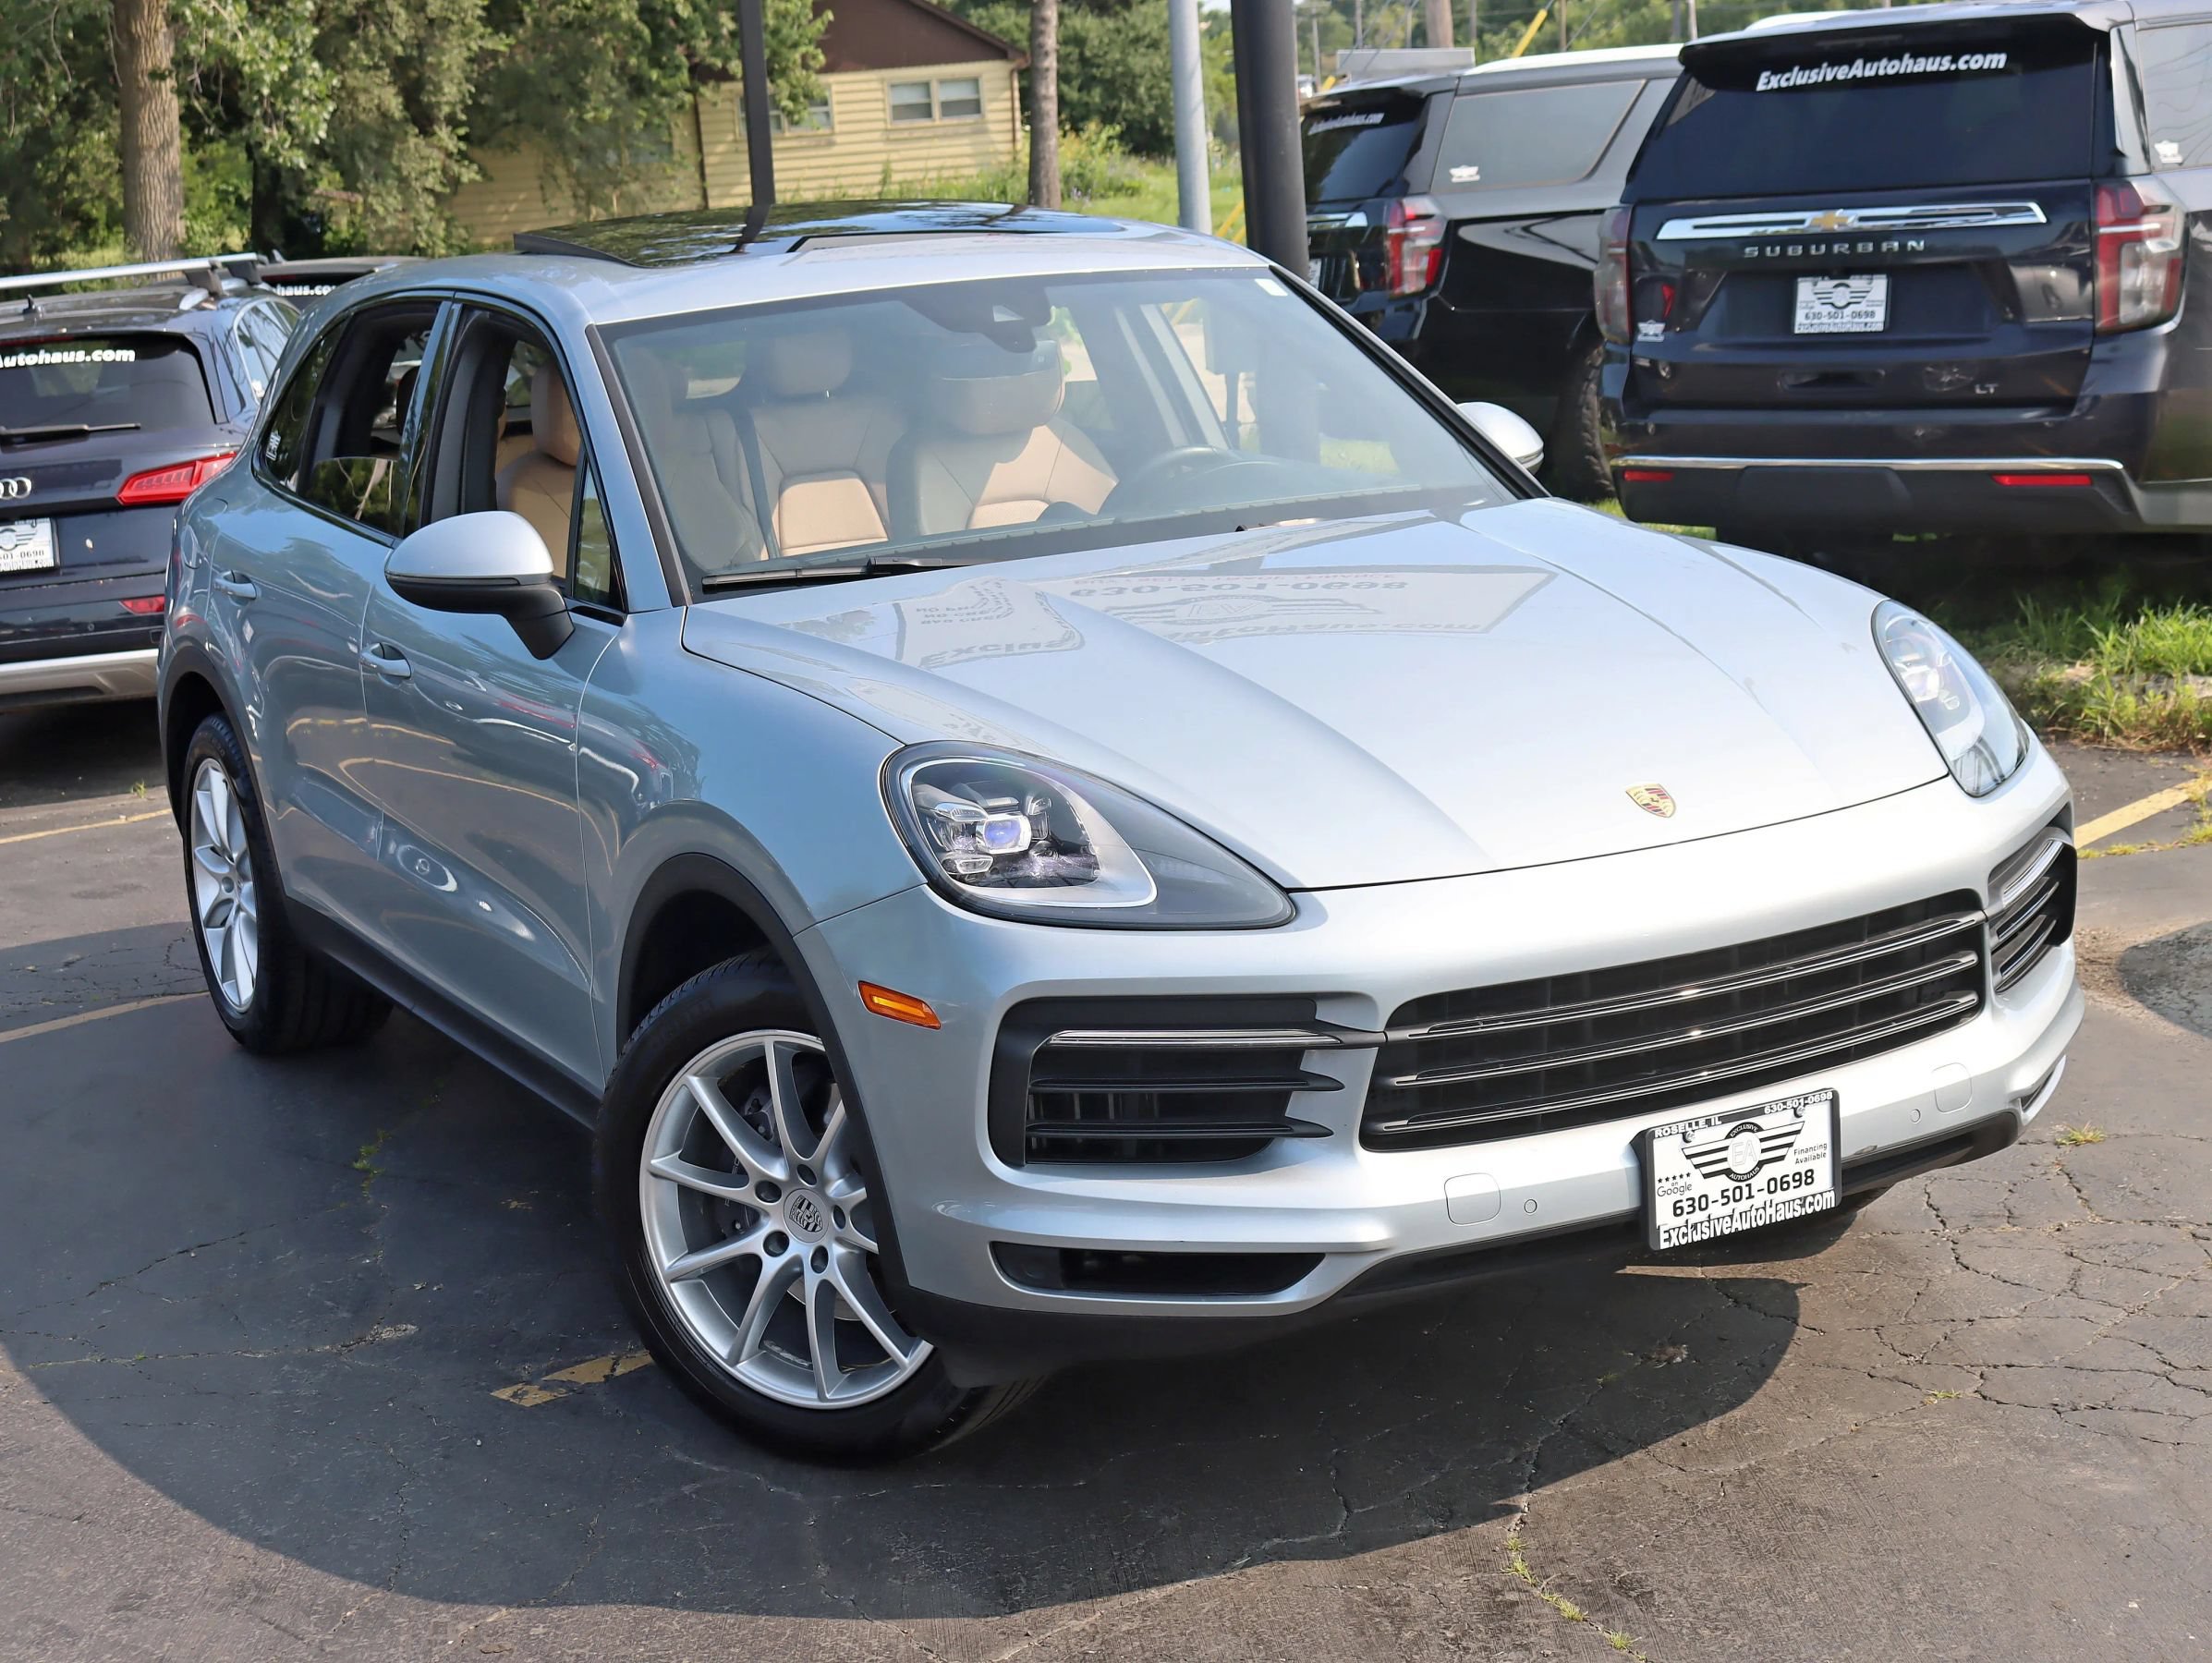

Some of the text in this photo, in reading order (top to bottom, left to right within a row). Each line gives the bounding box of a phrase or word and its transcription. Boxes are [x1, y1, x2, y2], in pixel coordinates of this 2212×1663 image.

[1756, 52, 2008, 91] ExclusiveAutohaus.com
[1744, 239, 1925, 258] SUBURBAN
[1805, 310, 1876, 321] 630-501-0698
[1975, 383, 1999, 395] LT
[1764, 1091, 1833, 1114] 630-501-0698
[1654, 1116, 1722, 1138] ROSELLE, IL
[1730, 1123, 1759, 1137] EXCLUSIVE
[1793, 1143, 1828, 1157] Financing
[1794, 1152, 1827, 1165] Available
[1729, 1167, 1760, 1181] AUTOHAUS
[1657, 1182, 1693, 1197] Google
[1672, 1169, 1815, 1218] 630-501-0698
[1659, 1190, 1835, 1250] ExclusiveAutoHaus.com
